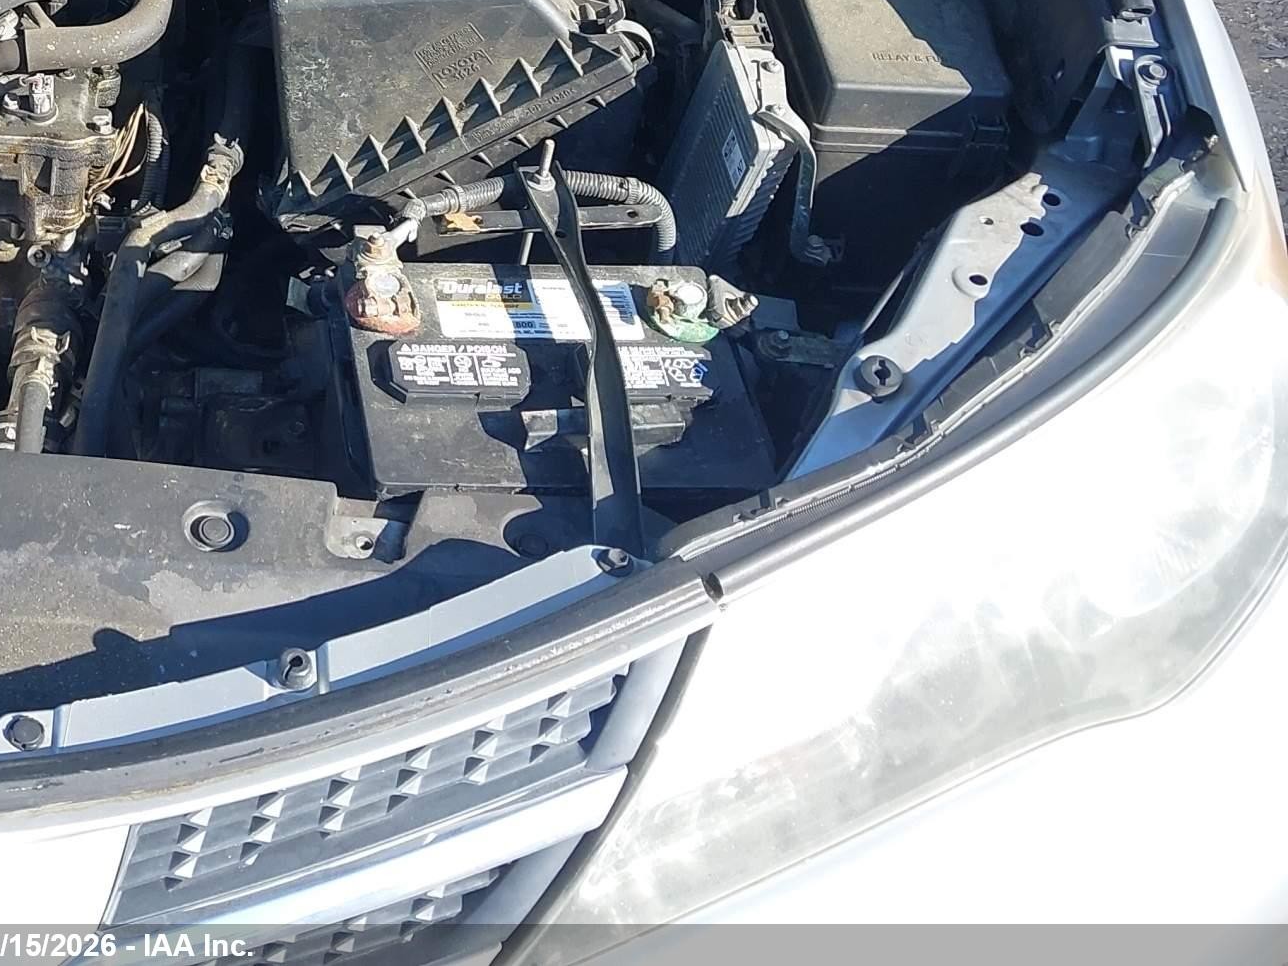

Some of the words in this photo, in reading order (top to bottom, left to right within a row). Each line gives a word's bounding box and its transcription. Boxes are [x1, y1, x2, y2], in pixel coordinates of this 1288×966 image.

[871, 52, 910, 62] RELAY
[436, 48, 488, 81] TOYOTA
[442, 280, 523, 294] Duralast
[411, 344, 457, 353] DANGER
[466, 345, 508, 354] POISON
